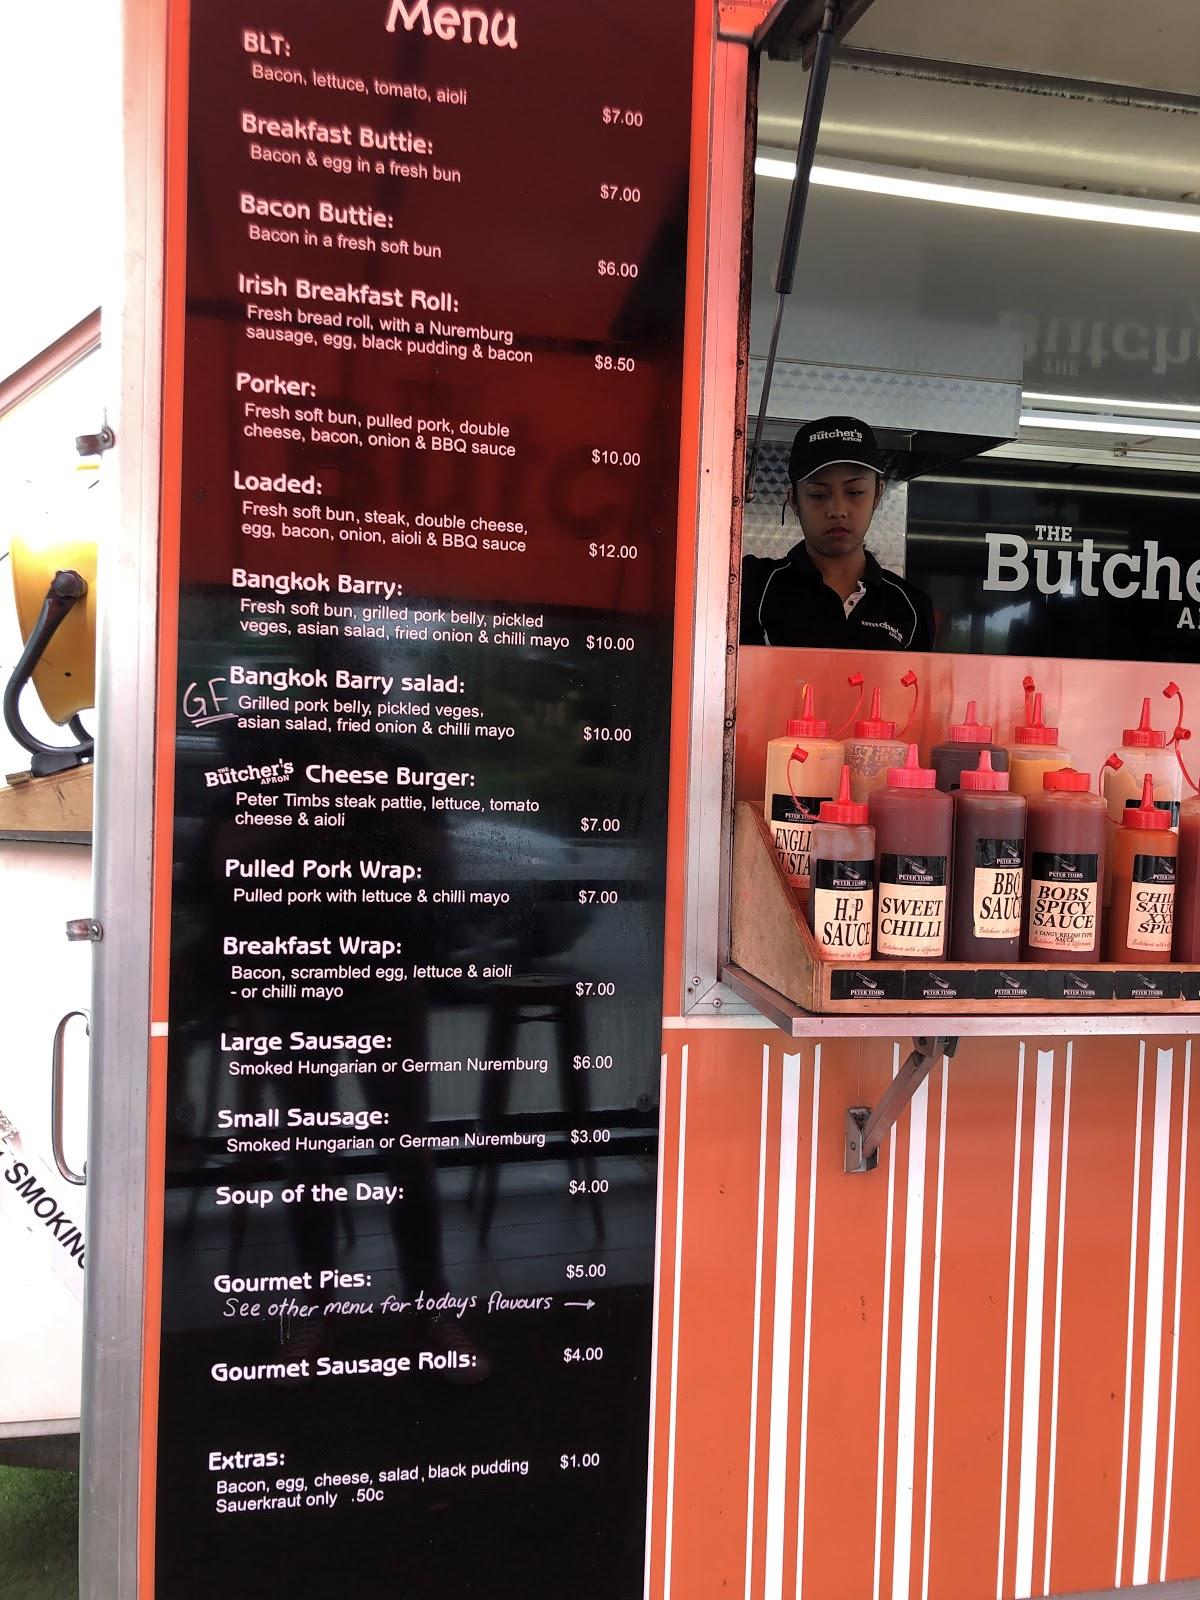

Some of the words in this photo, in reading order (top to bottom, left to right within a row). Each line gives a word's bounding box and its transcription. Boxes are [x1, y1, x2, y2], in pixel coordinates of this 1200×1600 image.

[388, 0, 522, 49] Menu
[244, 31, 291, 58] BLT:
[252, 62, 307, 86] Bacon,
[312, 70, 369, 96] lettuce,
[374, 79, 432, 103] tomato,
[436, 87, 467, 106] aioli
[602, 107, 643, 127] $7.00
[242, 112, 353, 146] Breakfast
[359, 127, 433, 155] Buttie:
[599, 183, 641, 203] $7.00
[240, 193, 311, 221] Bacon
[319, 201, 394, 229] Buttie:
[597, 259, 639, 278] $6.00
[239, 273, 288, 297] Irish
[296, 279, 404, 308] Breakfast
[411, 289, 459, 313] Roll:
[246, 327, 318, 347] sausage,
[322, 333, 357, 351] egg,
[362, 333, 403, 352] black
[407, 339, 468, 361] pudding
[472, 343, 484, 359] &
[487, 344, 533, 363] bacon
[594, 353, 635, 373] $8.50
[236, 372, 316, 398] Porker:
[591, 448, 641, 467] $10.00
[234, 470, 322, 496] Loaded:
[241, 523, 276, 539] egg,
[281, 522, 335, 542] bacon,
[339, 526, 386, 545] onion,
[391, 529, 422, 545] aioli
[426, 531, 438, 546] &
[442, 532, 478, 550] BBQ
[482, 538, 527, 553] sauce
[1034, 524, 1073, 542] THE
[588, 542, 638, 560] $12.00
[232, 568, 331, 595] Bangkok
[337, 574, 403, 601] Barry:
[585, 634, 635, 651] $10.00
[230, 665, 328, 692] Bangkok
[335, 669, 394, 696] Barry
[401, 673, 465, 694] salad:
[182, 677, 229, 718] GF
[238, 695, 290, 711] Grilled
[294, 698, 329, 715] pork
[333, 698, 372, 718] belly,
[377, 701, 430, 718] pickled
[434, 705, 484, 721] veges,
[583, 726, 632, 742] $10.00
[204, 758, 294, 787] Butcher's
[260, 775, 290, 785] APRON
[305, 764, 389, 785] Cheese
[396, 766, 475, 791] Burger:
[236, 791, 279, 807] Peter
[283, 792, 331, 808] Timbs
[334, 794, 377, 809] steak
[381, 795, 427, 812] pattie,
[431, 795, 485, 813] lettuce,
[489, 798, 540, 812] tomato
[580, 816, 621, 833] $7.00
[225, 858, 295, 878] Pulled
[303, 859, 353, 879] Pork
[359, 860, 422, 884] Wrap:
[578, 889, 618, 905] $7.00
[1036, 885, 1090, 902] BOBS
[880, 896, 944, 917] SWEET
[979, 896, 1021, 921] SAUC
[1034, 898, 1093, 915] SPICY
[880, 918, 943, 938] CHILLI
[1032, 912, 1095, 929] SAUCE
[822, 921, 871, 947] SAUCE
[223, 935, 332, 955] Breakfast
[338, 936, 402, 960] Wrap:
[575, 981, 616, 998] $7.00
[220, 1032, 283, 1056] Large
[289, 1031, 392, 1055] Sausage:
[228, 1060, 293, 1076] Smoked
[298, 1058, 377, 1078] Hungarian
[381, 1061, 398, 1073] or
[401, 1058, 462, 1073] German
[467, 1056, 548, 1074] Nuremburg
[572, 1054, 613, 1071] $6.00
[217, 1108, 280, 1129] Small
[286, 1108, 389, 1131] Sausage:
[570, 1128, 611, 1145] $3.00
[215, 1186, 274, 1209] Soup
[281, 1183, 306, 1204] of
[310, 1183, 348, 1203] the
[356, 1182, 404, 1205] Day:
[568, 1179, 609, 1196] $4.00
[213, 1271, 313, 1294] Gourmet
[319, 1269, 372, 1289] Pies:
[566, 1263, 606, 1280] $5.00
[222, 1297, 261, 1317] See
[267, 1297, 320, 1320] other
[323, 1301, 374, 1316] menu
[380, 1294, 412, 1314] for
[414, 1289, 478, 1319] todays
[487, 1290, 553, 1314] flavours
[210, 1358, 310, 1382] Gourmet
[316, 1356, 411, 1377] Sausage
[418, 1350, 477, 1370] Rolls:
[563, 1346, 604, 1364] $4.00
[208, 1450, 285, 1471] Extras:
[559, 1452, 600, 1471] $1.00
[216, 1480, 270, 1495] Bacon,
[275, 1477, 308, 1493] egg,
[314, 1472, 373, 1488] cheese,
[378, 1465, 425, 1483] salad,
[428, 1462, 467, 1479] black
[471, 1458, 529, 1479] pudding
[215, 1493, 302, 1513] Sauerkraut
[305, 1490, 338, 1508] only
[351, 1487, 384, 1503] .50c
